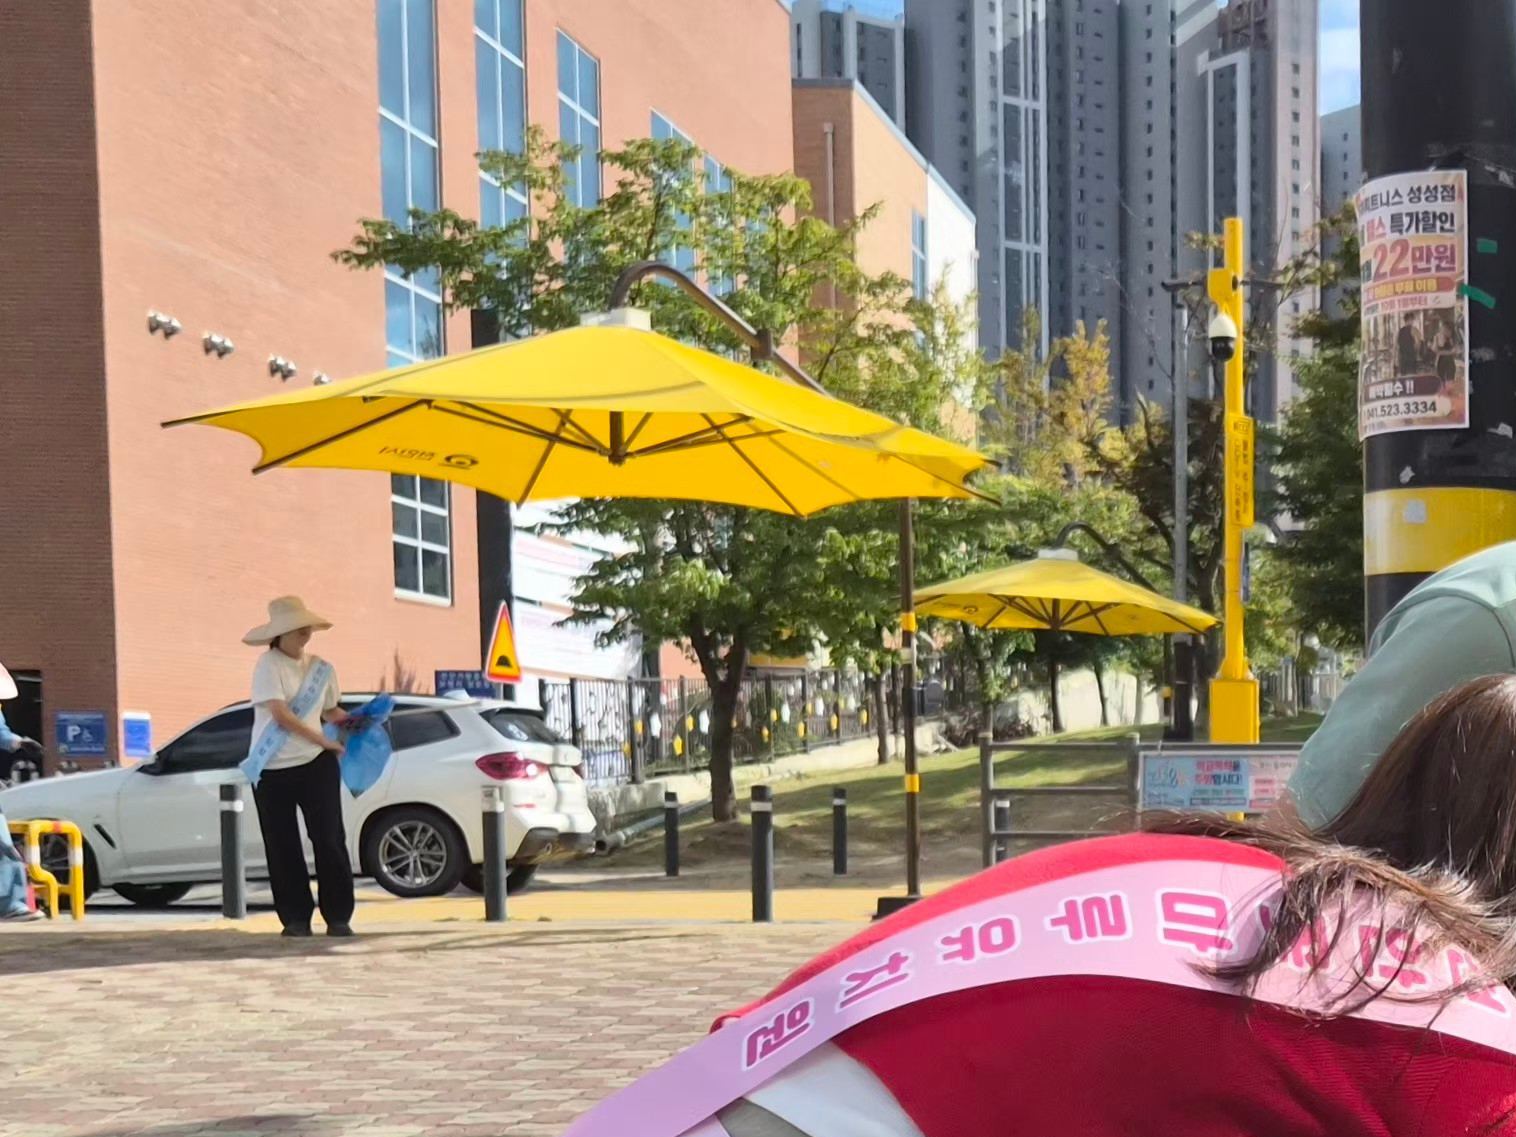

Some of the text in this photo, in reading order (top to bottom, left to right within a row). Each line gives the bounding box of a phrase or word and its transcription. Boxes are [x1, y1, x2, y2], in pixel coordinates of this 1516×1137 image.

[1360, 184, 1455, 214] 피트니스 성성점
[1390, 210, 1456, 235] 특가할인
[1373, 239, 1456, 282] 22만원
[66, 725, 81, 742] P
